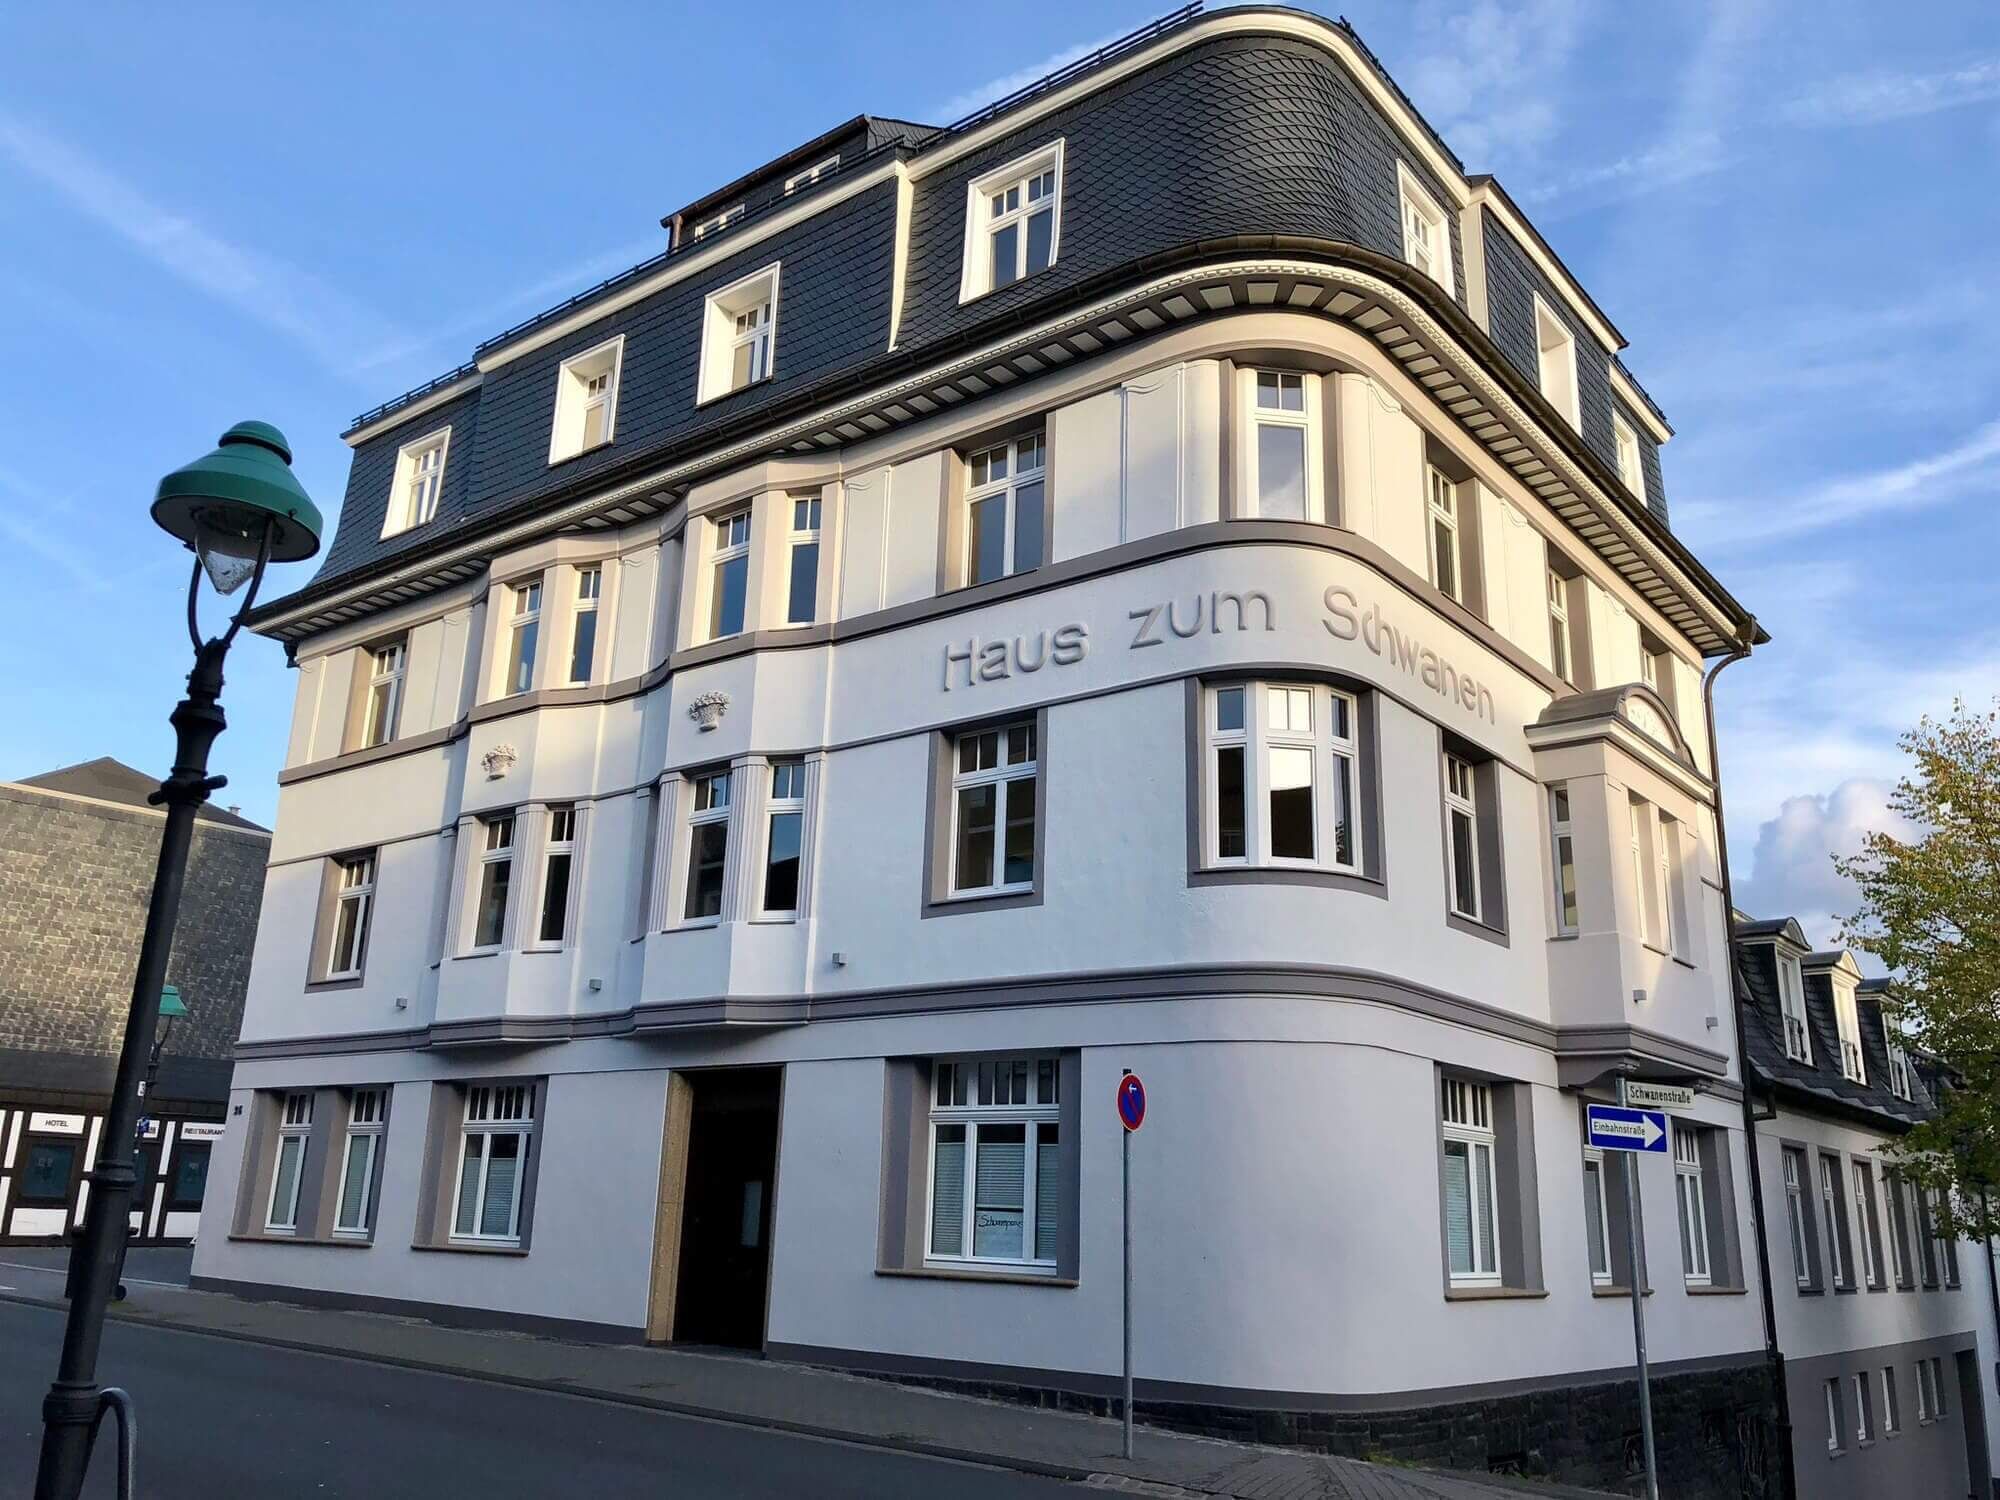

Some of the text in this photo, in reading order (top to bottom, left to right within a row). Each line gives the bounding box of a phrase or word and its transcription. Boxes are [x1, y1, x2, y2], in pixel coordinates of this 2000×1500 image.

[943, 586, 1494, 725] Haus zum Schwanen
[1630, 1085, 1692, 1104] Schwanenstraße
[45, 1119, 69, 1128] HOTEL
[1593, 1121, 1646, 1136] Einbahnstraße
